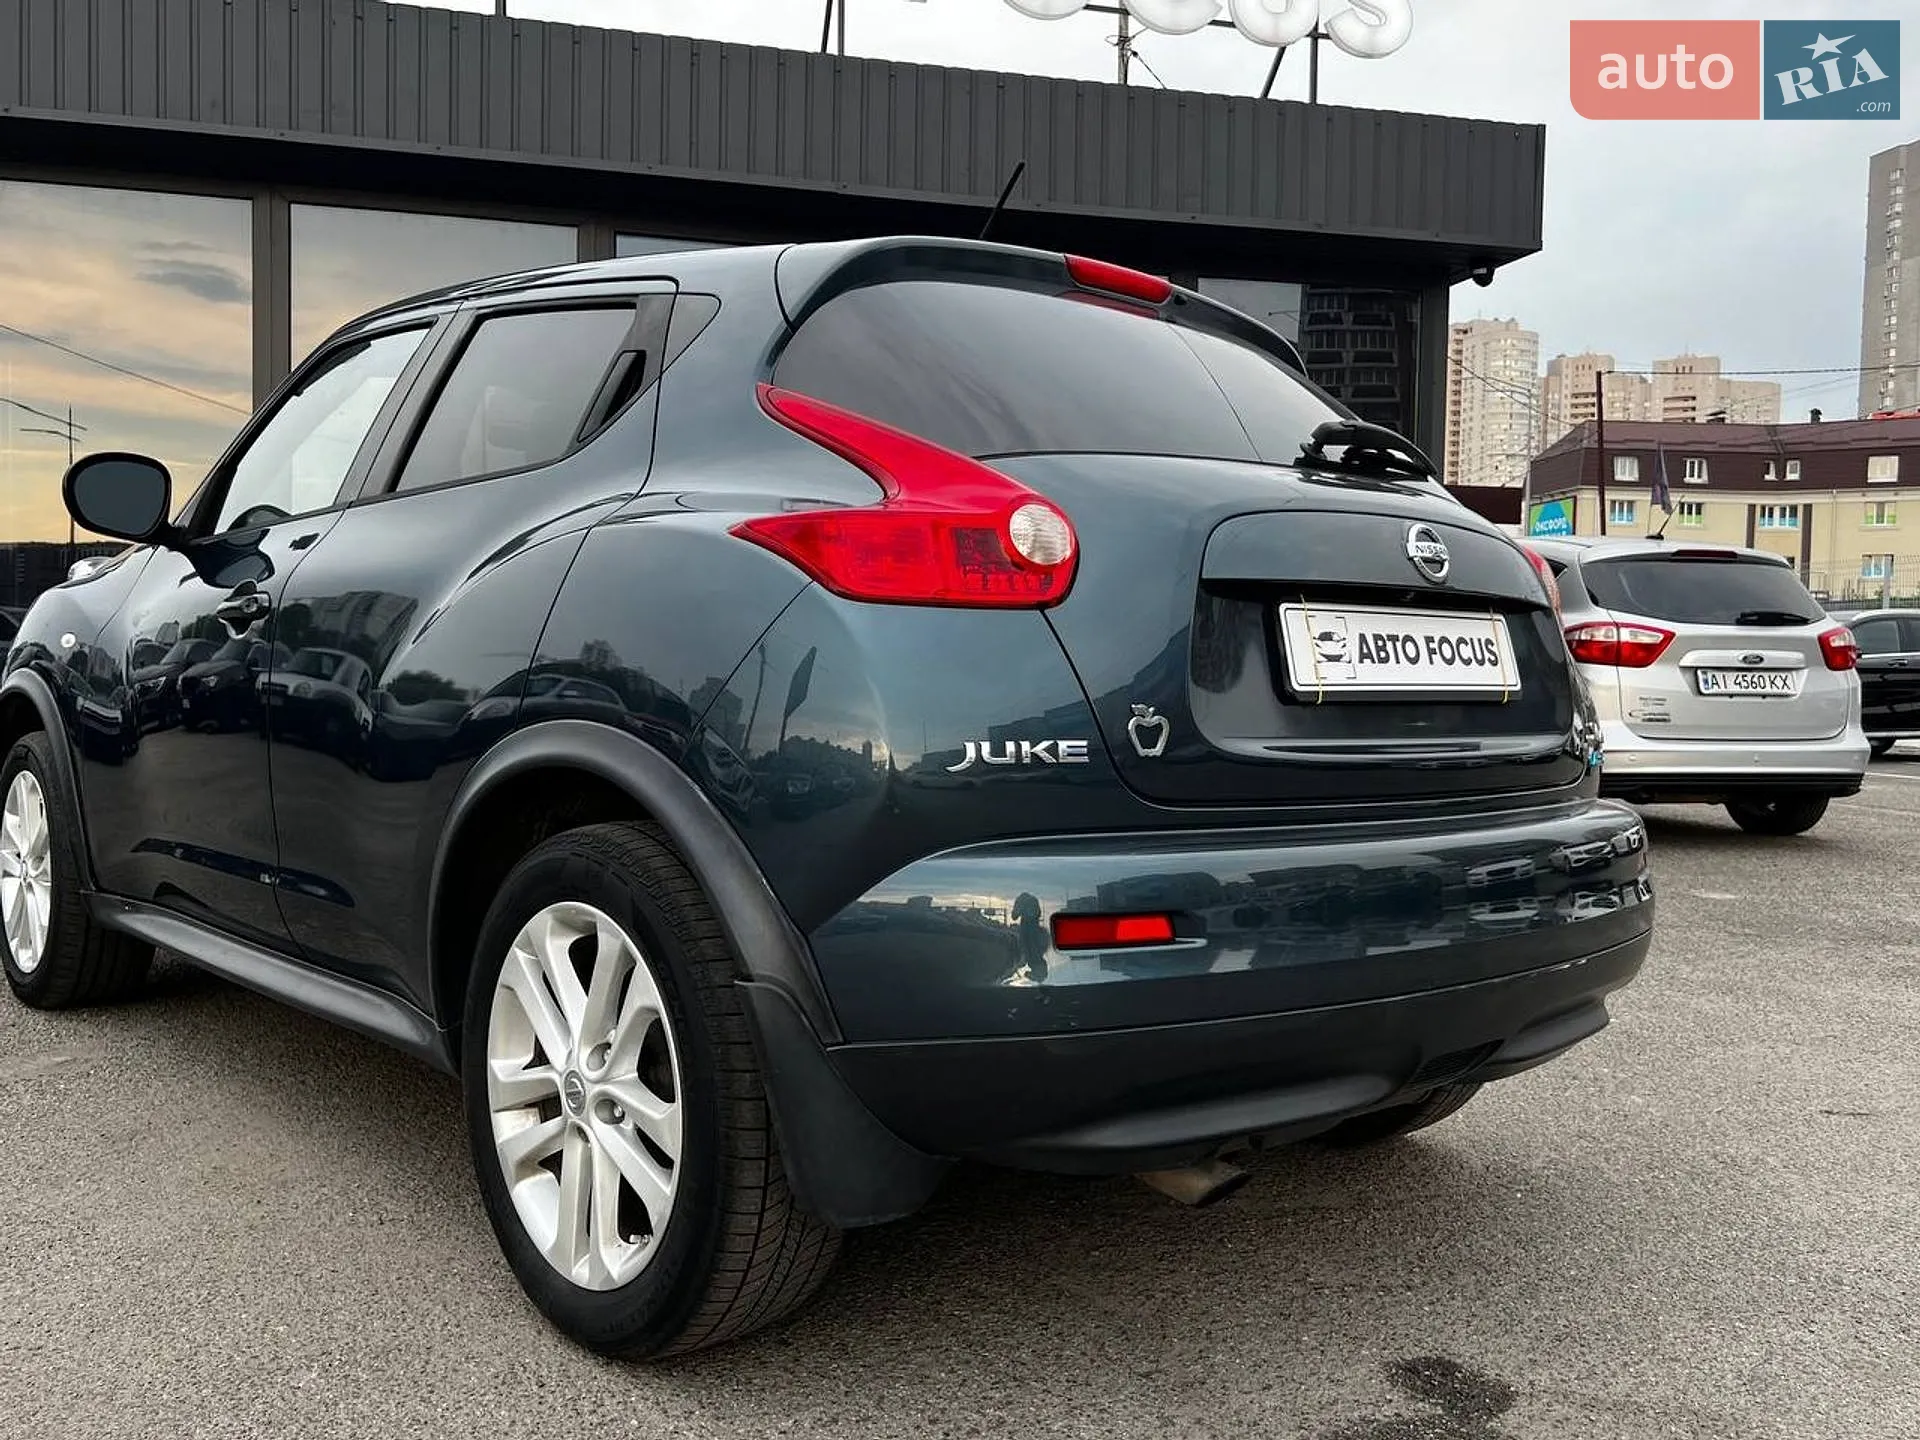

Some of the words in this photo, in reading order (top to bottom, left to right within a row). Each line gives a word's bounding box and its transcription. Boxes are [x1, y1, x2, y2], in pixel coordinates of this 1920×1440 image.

[1426, 635, 1498, 667] FOCUS
[1734, 673, 1766, 690] 4560
[1769, 674, 1791, 690] KX
[945, 740, 1089, 773] JUKE
